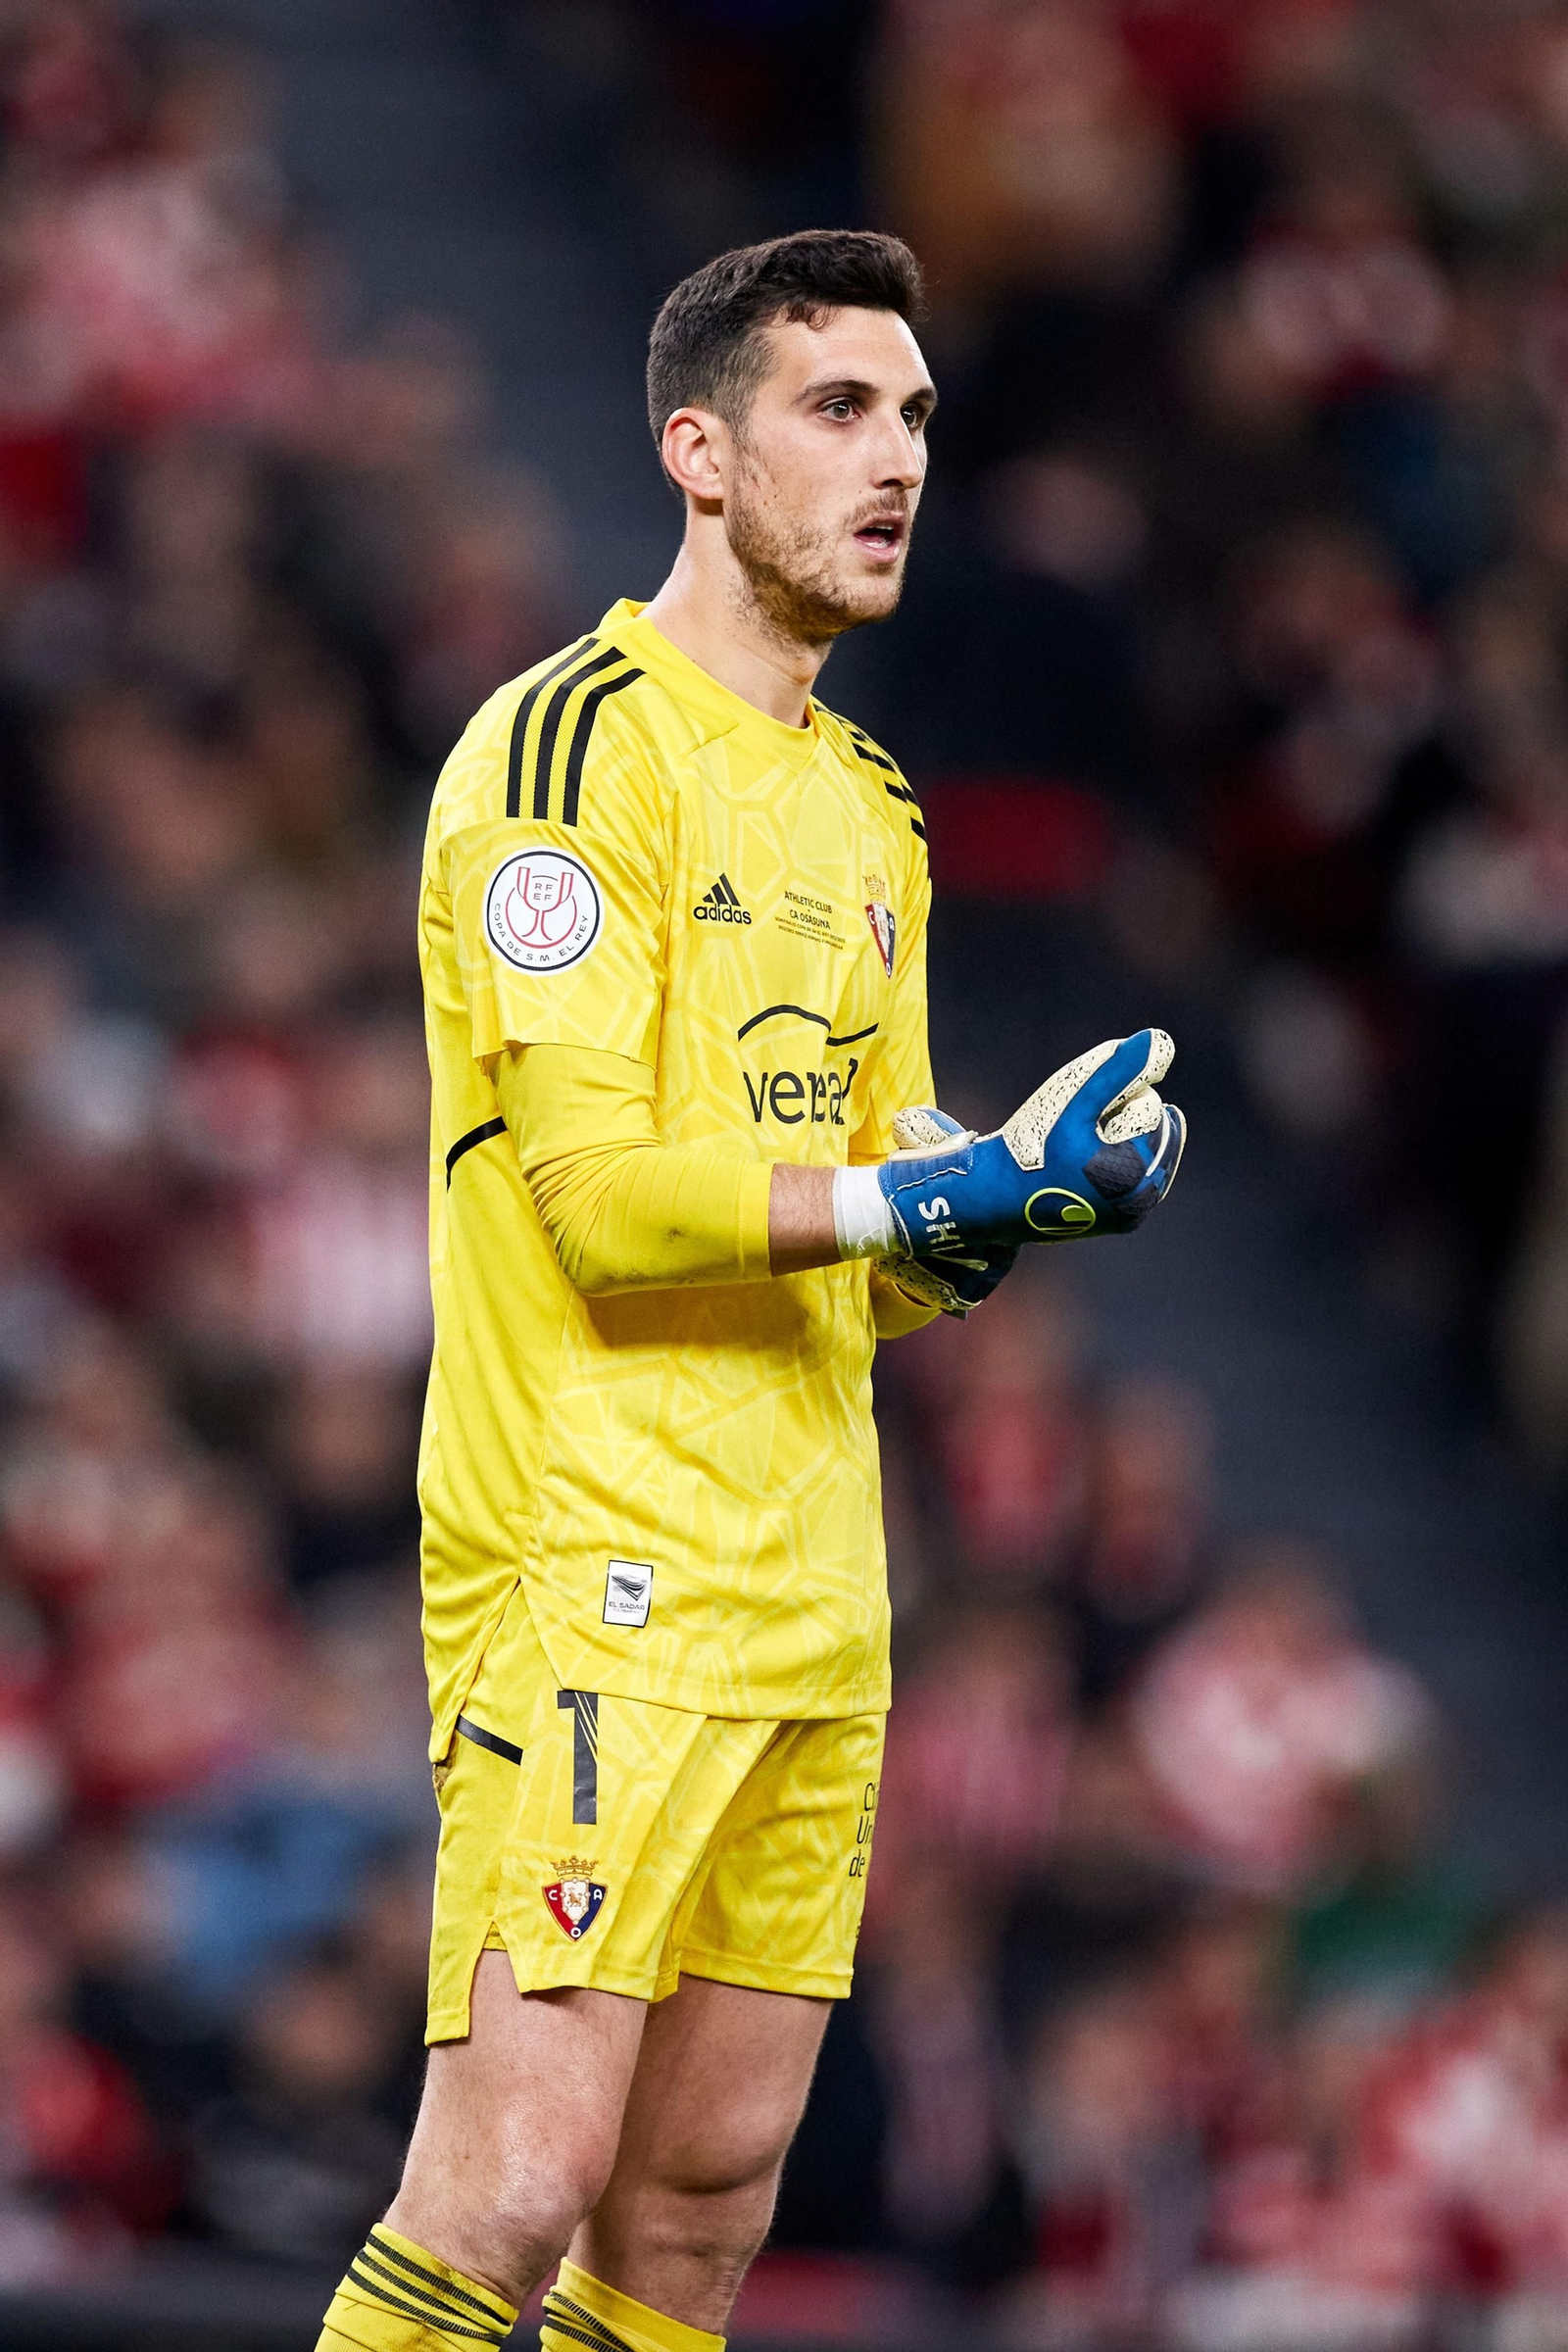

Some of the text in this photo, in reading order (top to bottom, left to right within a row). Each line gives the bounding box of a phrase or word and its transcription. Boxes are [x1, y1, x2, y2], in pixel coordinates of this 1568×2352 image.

[693, 903, 753, 925] adidas
[784, 891, 833, 914] ATHLETIC CLUB
[494, 903, 507, 938] COPA
[506, 941, 522, 956] DE
[559, 946, 575, 956] EL
[574, 914, 588, 942] REY
[789, 909, 799, 920] CA
[800, 912, 831, 930] OSASUNA
[557, 1689, 599, 1826] 1
[849, 1848, 865, 1878] de
